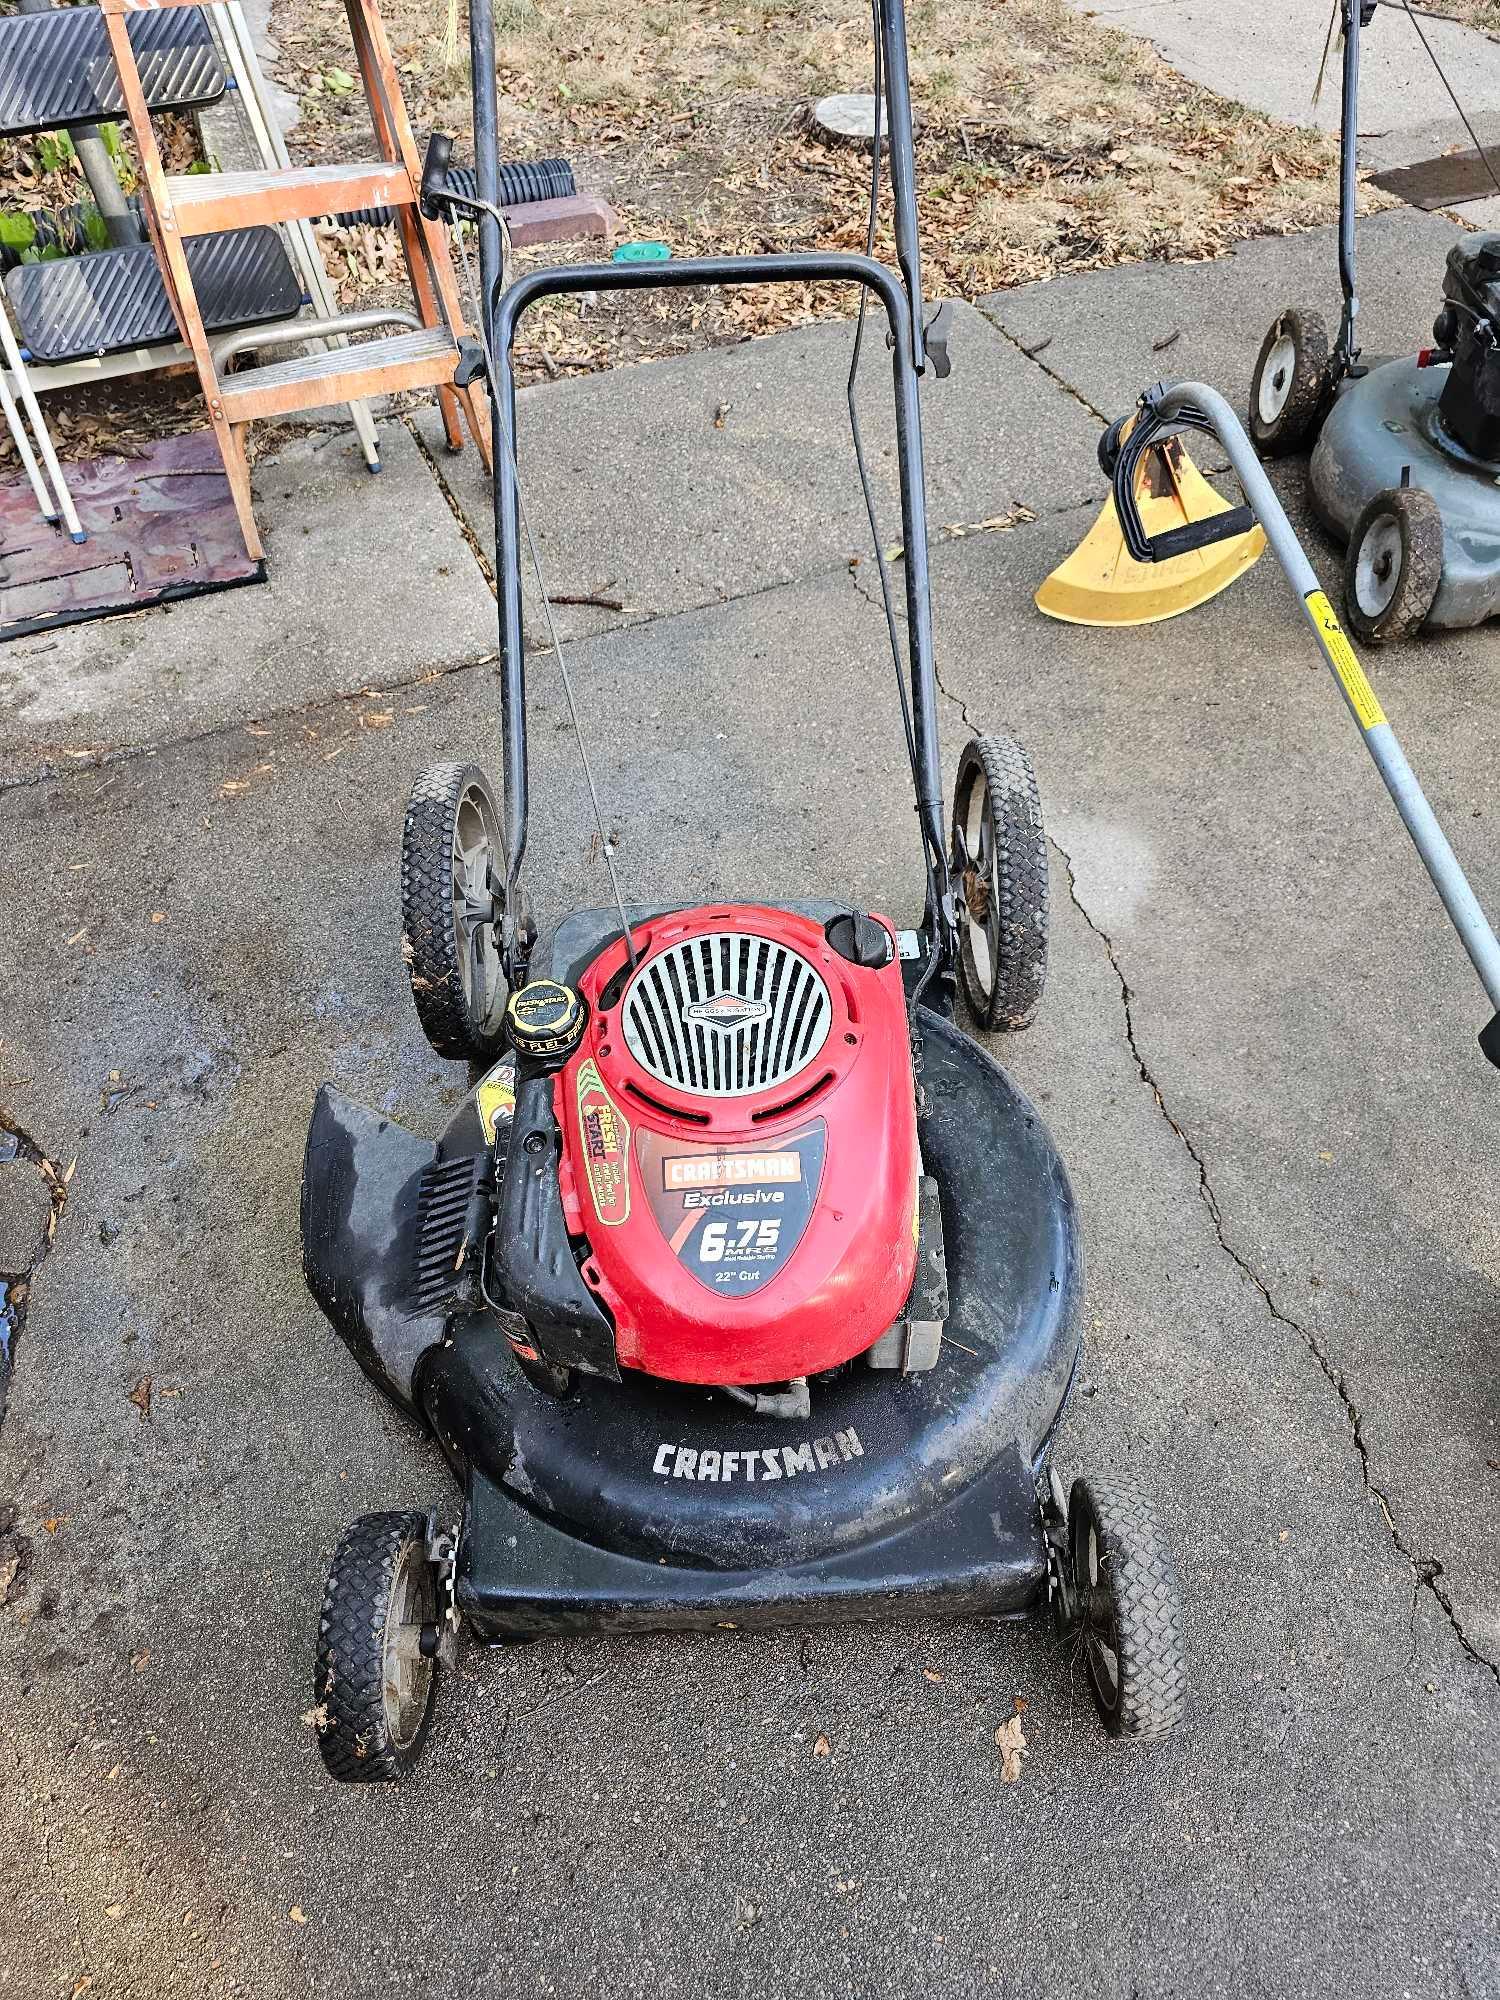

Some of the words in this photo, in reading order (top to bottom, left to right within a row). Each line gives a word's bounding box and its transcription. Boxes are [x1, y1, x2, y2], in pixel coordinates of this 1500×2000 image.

[587, 1113, 606, 1159] START
[597, 1105, 618, 1153] FRESH
[671, 1157, 795, 1182] CRAFTSMAN
[683, 1189, 785, 1209] Exclusive
[699, 1218, 782, 1262] 6.75
[715, 1271, 737, 1282] 22"
[738, 1269, 760, 1281] Cut
[652, 1426, 865, 1482] CRAFTSMAN
